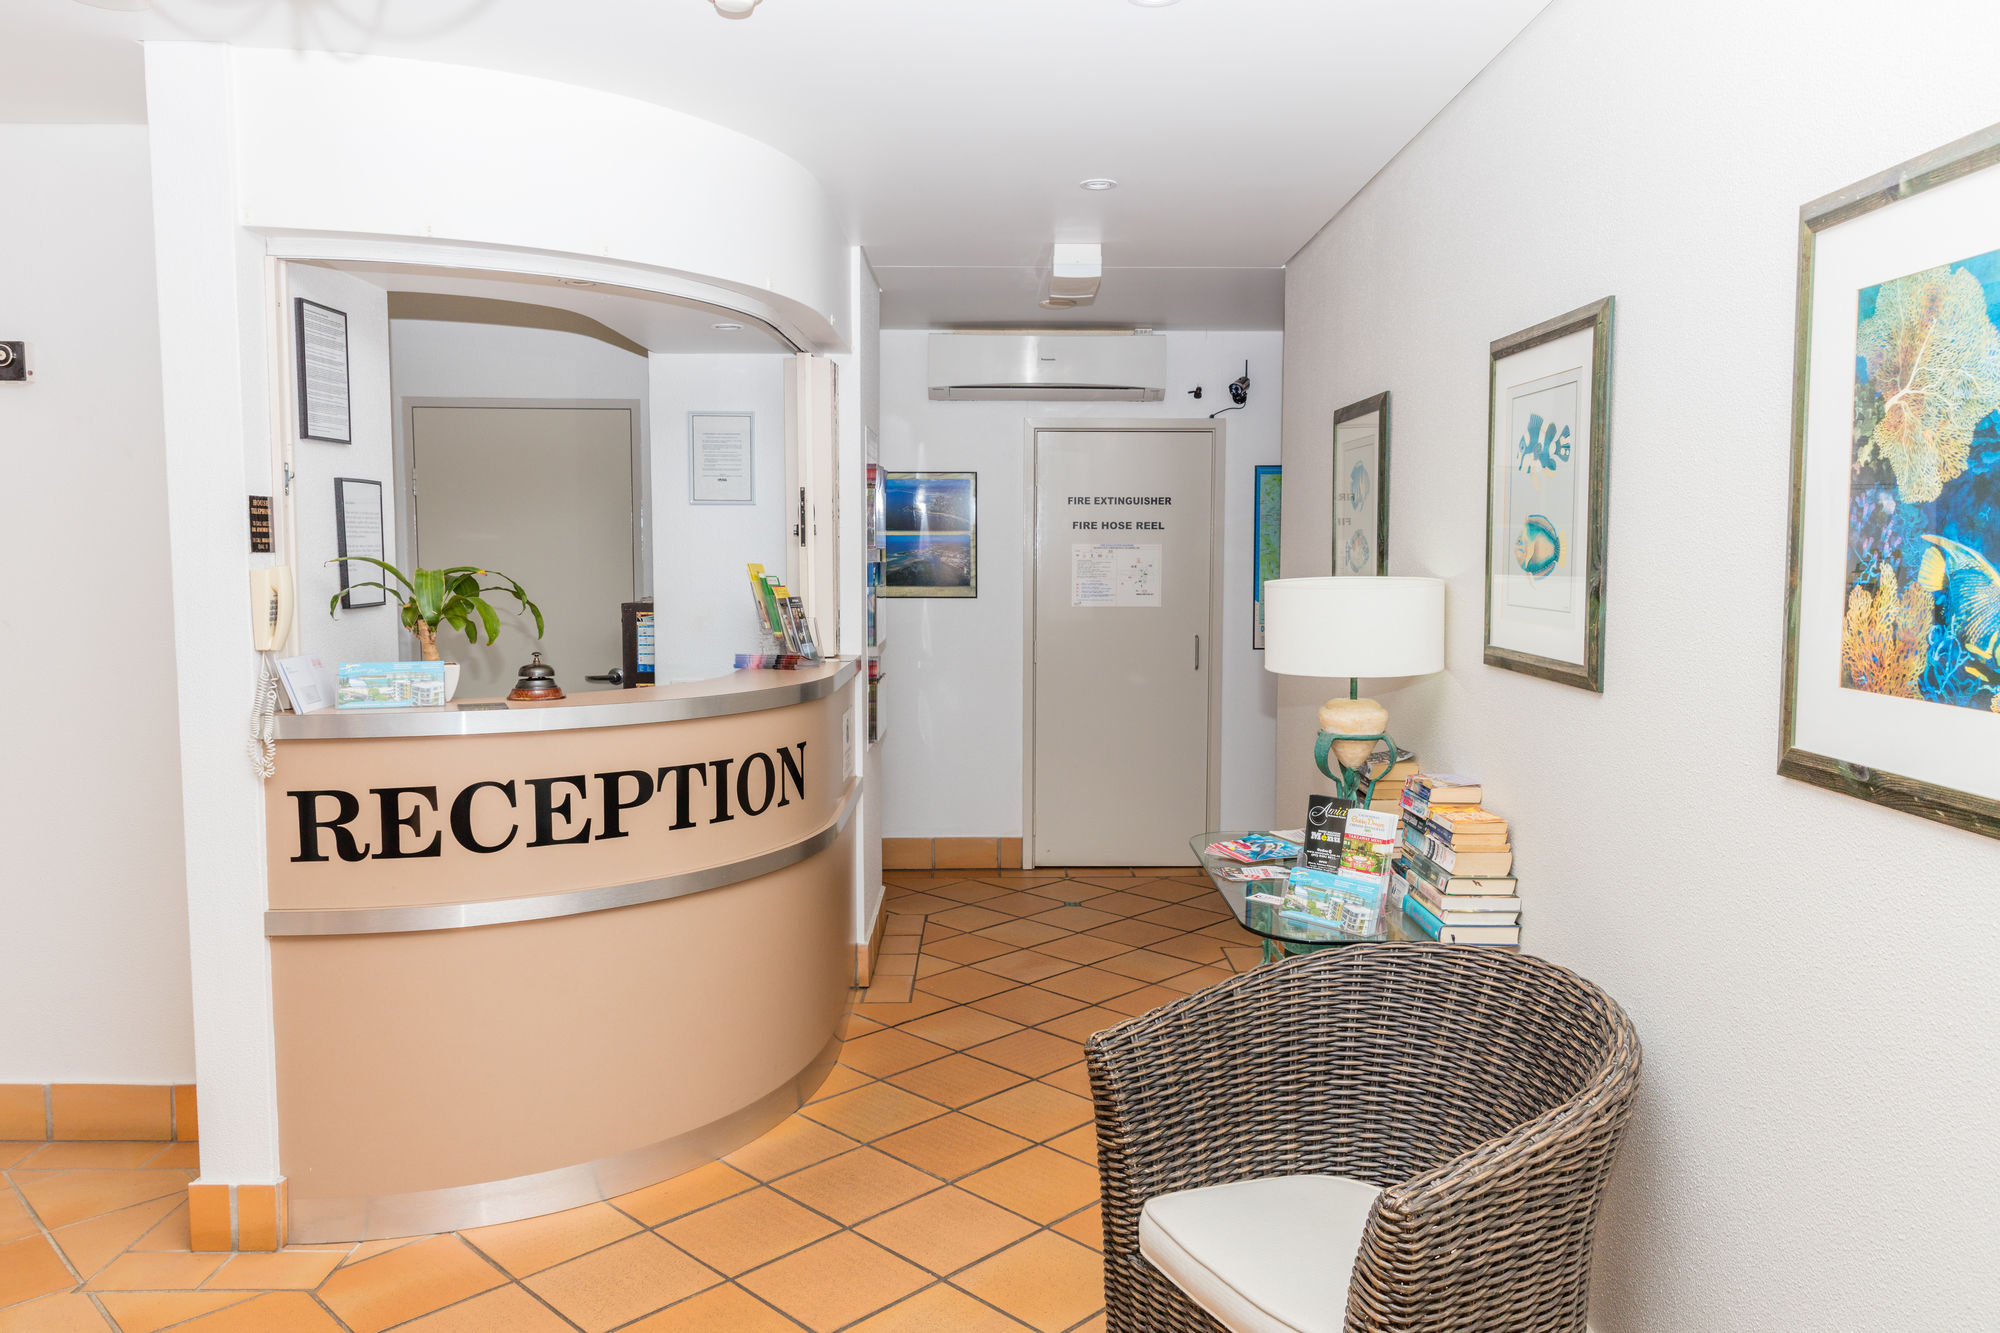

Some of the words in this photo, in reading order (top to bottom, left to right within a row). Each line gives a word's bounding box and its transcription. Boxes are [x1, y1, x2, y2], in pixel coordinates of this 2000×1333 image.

[1067, 496, 1091, 505] FIRE
[1094, 496, 1172, 505] EXTINGUISHER
[1072, 521, 1098, 530] FIRE
[1101, 521, 1133, 530] HOSE
[1136, 521, 1165, 530] REEL
[286, 741, 807, 864] RECEPTION
[1308, 802, 1349, 826] Amici
